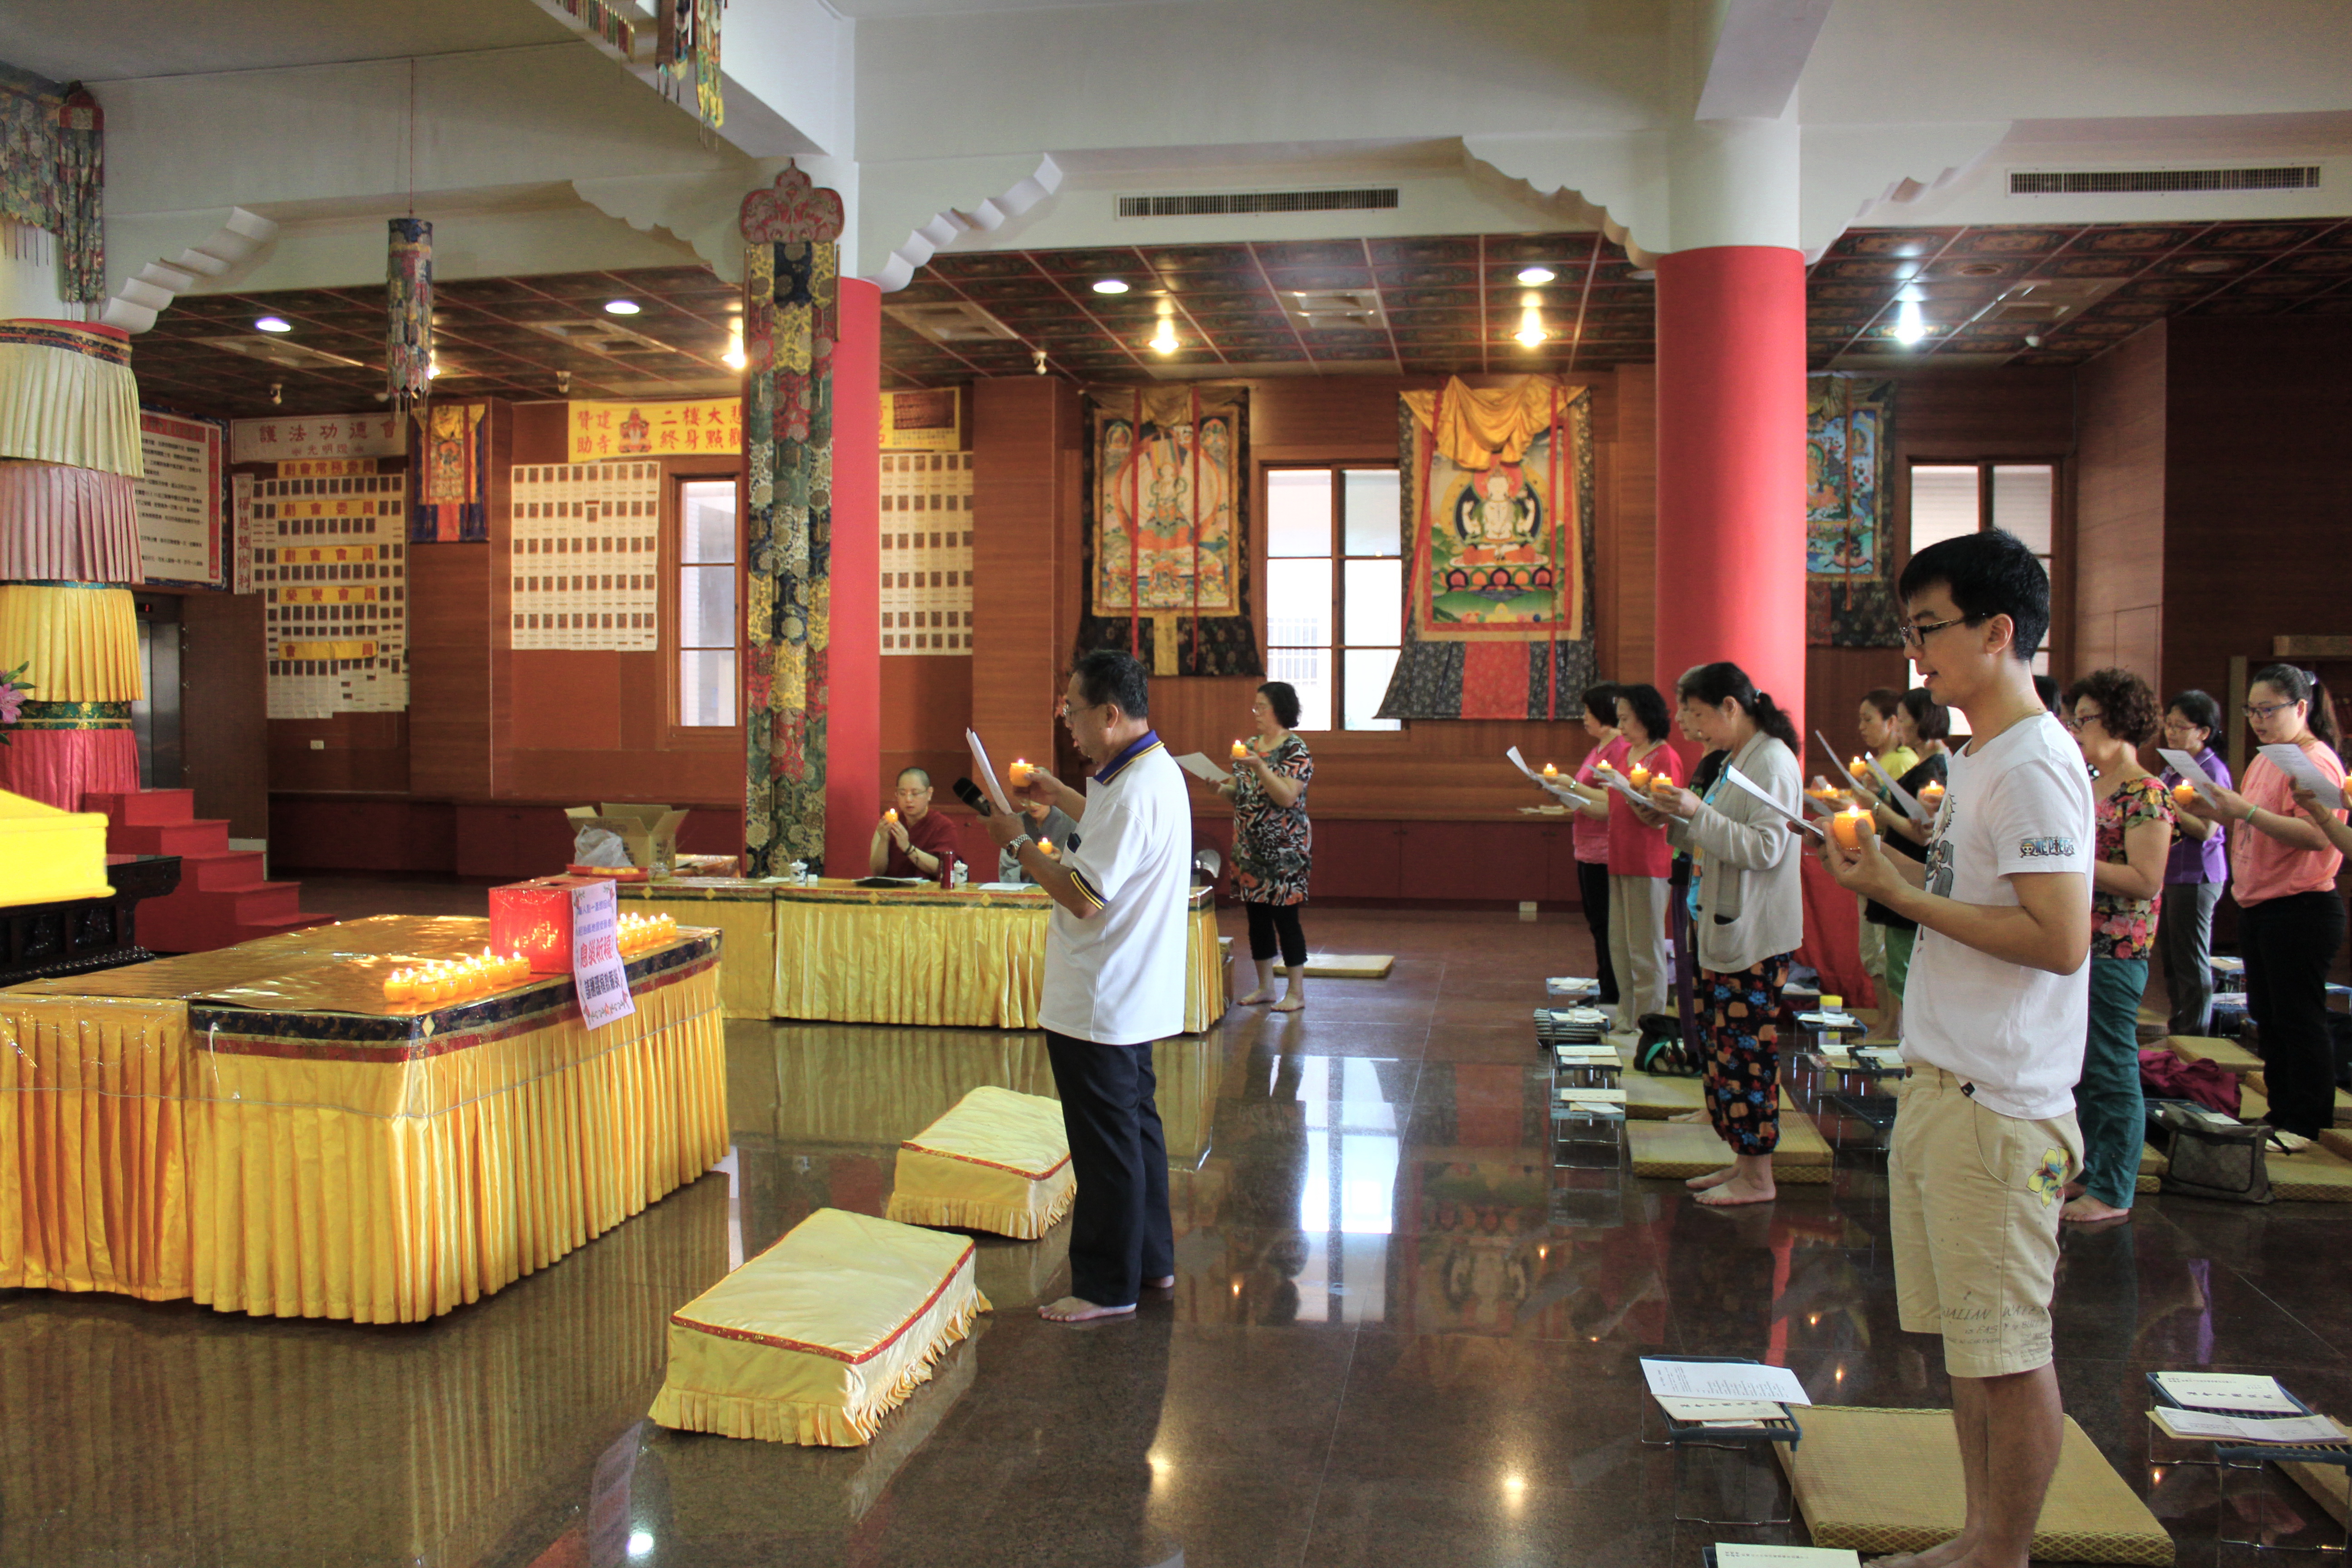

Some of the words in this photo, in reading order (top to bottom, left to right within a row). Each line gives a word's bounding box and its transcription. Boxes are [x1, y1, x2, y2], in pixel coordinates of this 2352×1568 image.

[260, 420, 396, 443] 護法功德會
